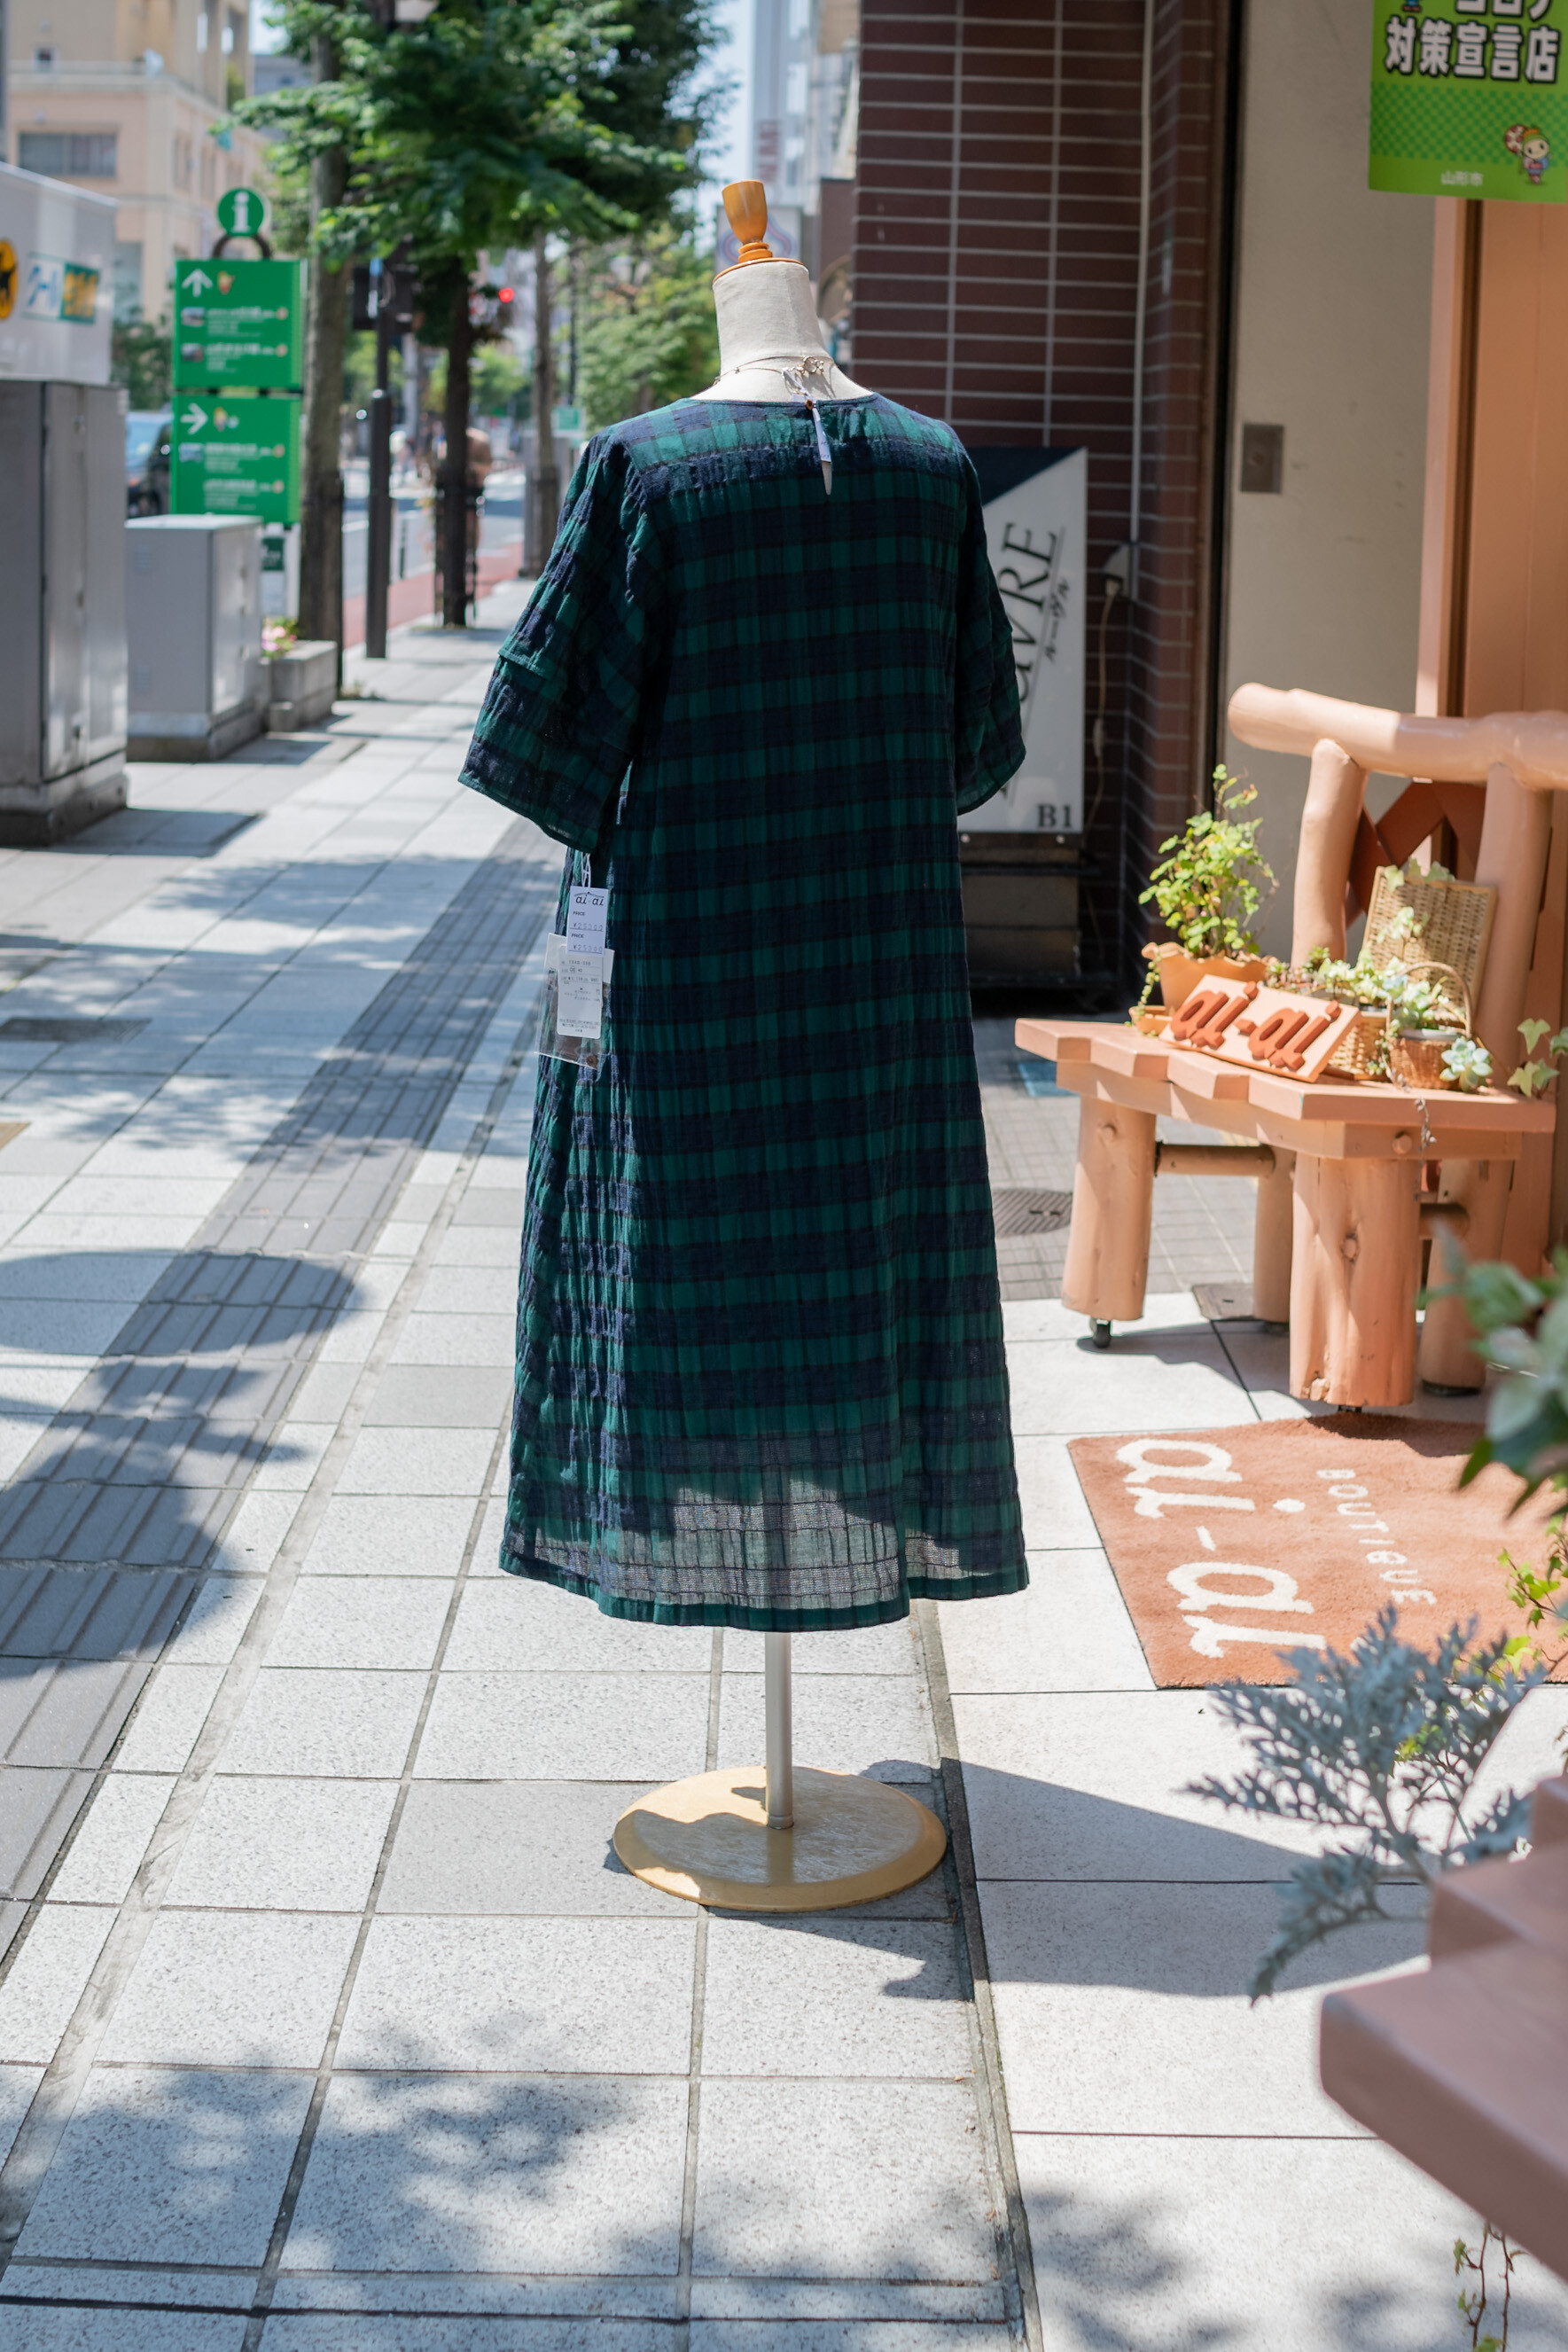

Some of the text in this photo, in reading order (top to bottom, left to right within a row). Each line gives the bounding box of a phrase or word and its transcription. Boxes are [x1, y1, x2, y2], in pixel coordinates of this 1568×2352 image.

[1385, 15, 1560, 83] 対策宣言店
[1037, 803, 1072, 828] B1
[1170, 981, 1342, 1072] ai-ai
[1316, 1468, 1438, 1606] BOUTIQUE
